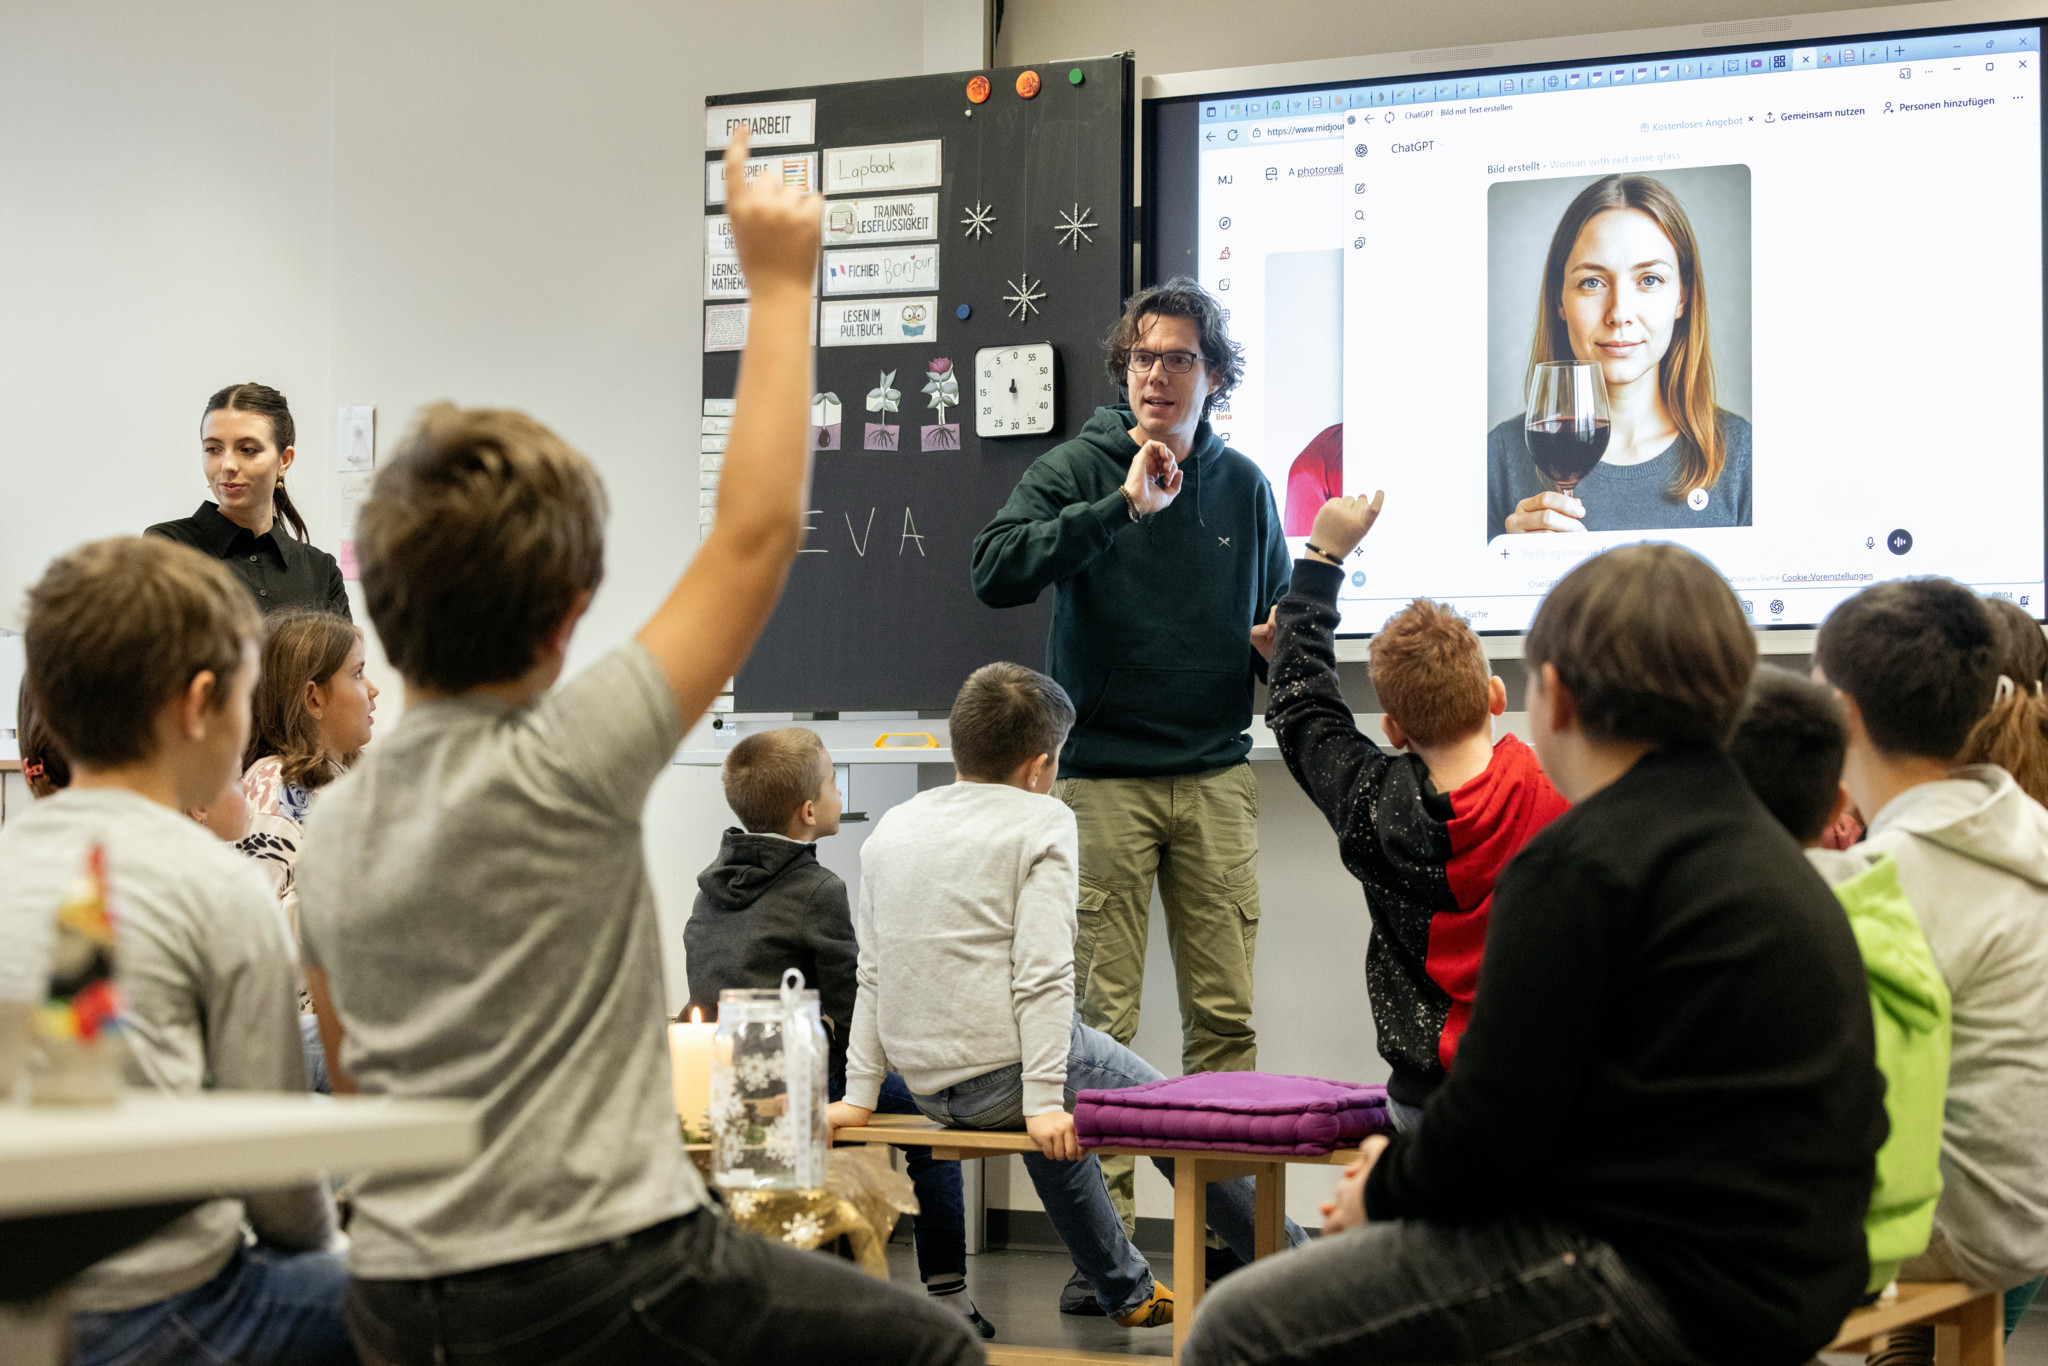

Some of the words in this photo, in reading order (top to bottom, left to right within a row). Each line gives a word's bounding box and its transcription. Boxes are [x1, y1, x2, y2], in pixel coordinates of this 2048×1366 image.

[1404, 110, 1434, 120] ChatGPT
[1440, 108, 1454, 116] Bild
[1470, 106, 1482, 114] Text
[1484, 104, 1512, 112] erstellen
[1900, 101, 1940, 112] Personen
[1944, 97, 1995, 108] hinzufügen
[1780, 110, 1832, 122] Gemeinsam
[1835, 106, 1865, 117] nutzen
[1652, 120, 1703, 132] Kostenloses
[1706, 116, 1743, 129] Angebot
[1391, 140, 1434, 154] ChatGPT
[839, 152, 896, 186] Lapbook
[1487, 164, 1505, 174] Bild
[1508, 162, 1540, 173] erstellt
[1550, 158, 1586, 170] Woman
[1590, 156, 1610, 167] with
[1612, 154, 1628, 166] red
[1632, 153, 1654, 164] wine
[1657, 151, 1681, 164] glass
[1288, 168, 1295, 176] A
[1298, 164, 1344, 178] photoreali
[1218, 175, 1233, 184] MJ
[874, 203, 916, 218] TRAINING:
[848, 264, 880, 278] FICHIER
[884, 255, 932, 284] Bonjour
[843, 308, 870, 323] LESEN
[872, 308, 880, 322] IM
[840, 323, 882, 338] PULTBUCH
[1011, 422, 1020, 430] 30
[1028, 416, 1036, 424] 35
[1782, 572, 1874, 582] Cookie-Voreinstellungen
[1464, 610, 1488, 618] Suche
